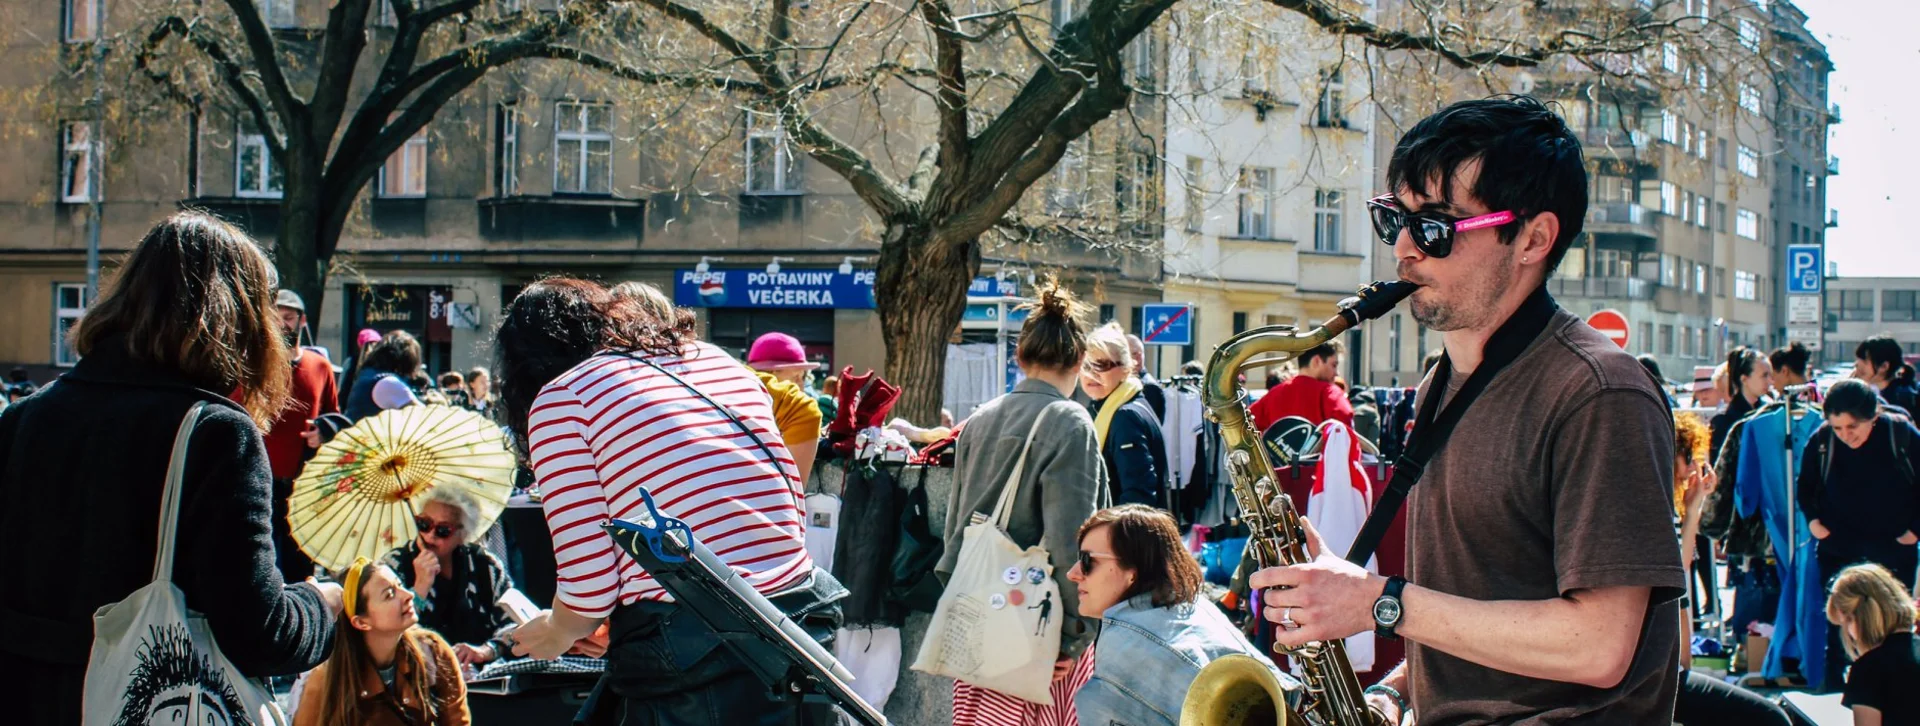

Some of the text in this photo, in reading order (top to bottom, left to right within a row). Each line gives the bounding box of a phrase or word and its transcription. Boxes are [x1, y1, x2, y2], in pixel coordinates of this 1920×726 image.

[1794, 252, 1814, 278] P
[682, 271, 726, 284] PEPSI
[747, 272, 833, 285] POTRAVINY
[747, 286, 834, 305] VEČERKA
